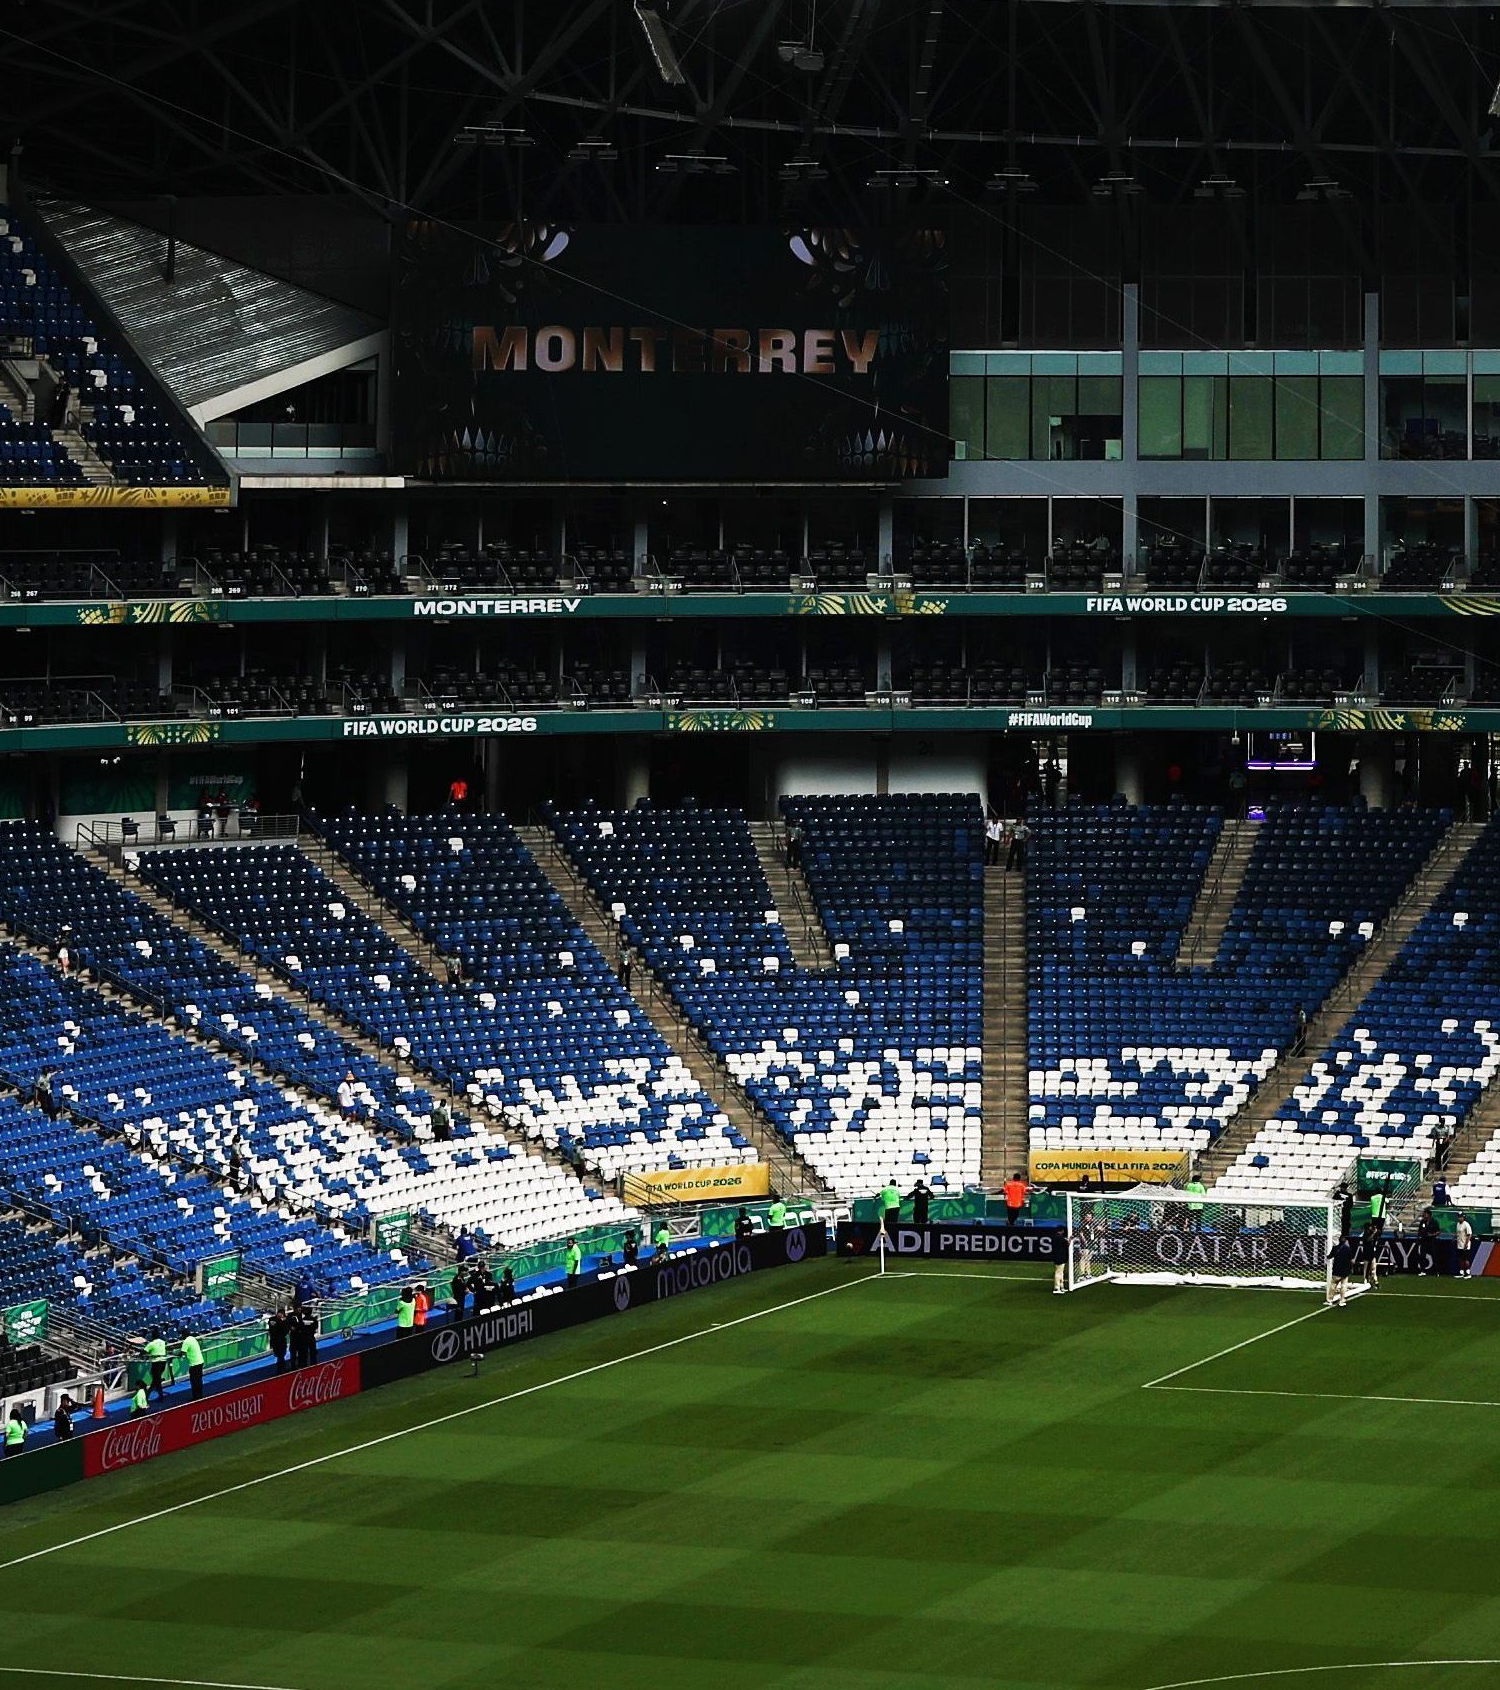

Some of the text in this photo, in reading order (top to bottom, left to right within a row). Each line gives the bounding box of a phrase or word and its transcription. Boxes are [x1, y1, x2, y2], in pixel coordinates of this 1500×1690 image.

[471, 324, 880, 374] MONTERREY
[413, 598, 581, 614] MONTERREY
[1087, 598, 1287, 611] FIFA WORLD CUP 2026
[344, 717, 536, 735] FIFA WORLD CUP 2026
[1035, 1162, 1060, 1170] COPA
[1131, 1163, 1150, 1171] FIFA
[664, 1181, 693, 1191] WORLD
[695, 1179, 711, 1188] CUP
[713, 1176, 742, 1187] 2026
[871, 1231, 930, 1253] ADI
[1155, 1234, 1271, 1266] QATAR
[658, 1240, 751, 1300] motorola
[463, 1309, 533, 1351] HYUNDAI
[191, 1404, 223, 1435] zero
[224, 1392, 264, 1425] sugar
